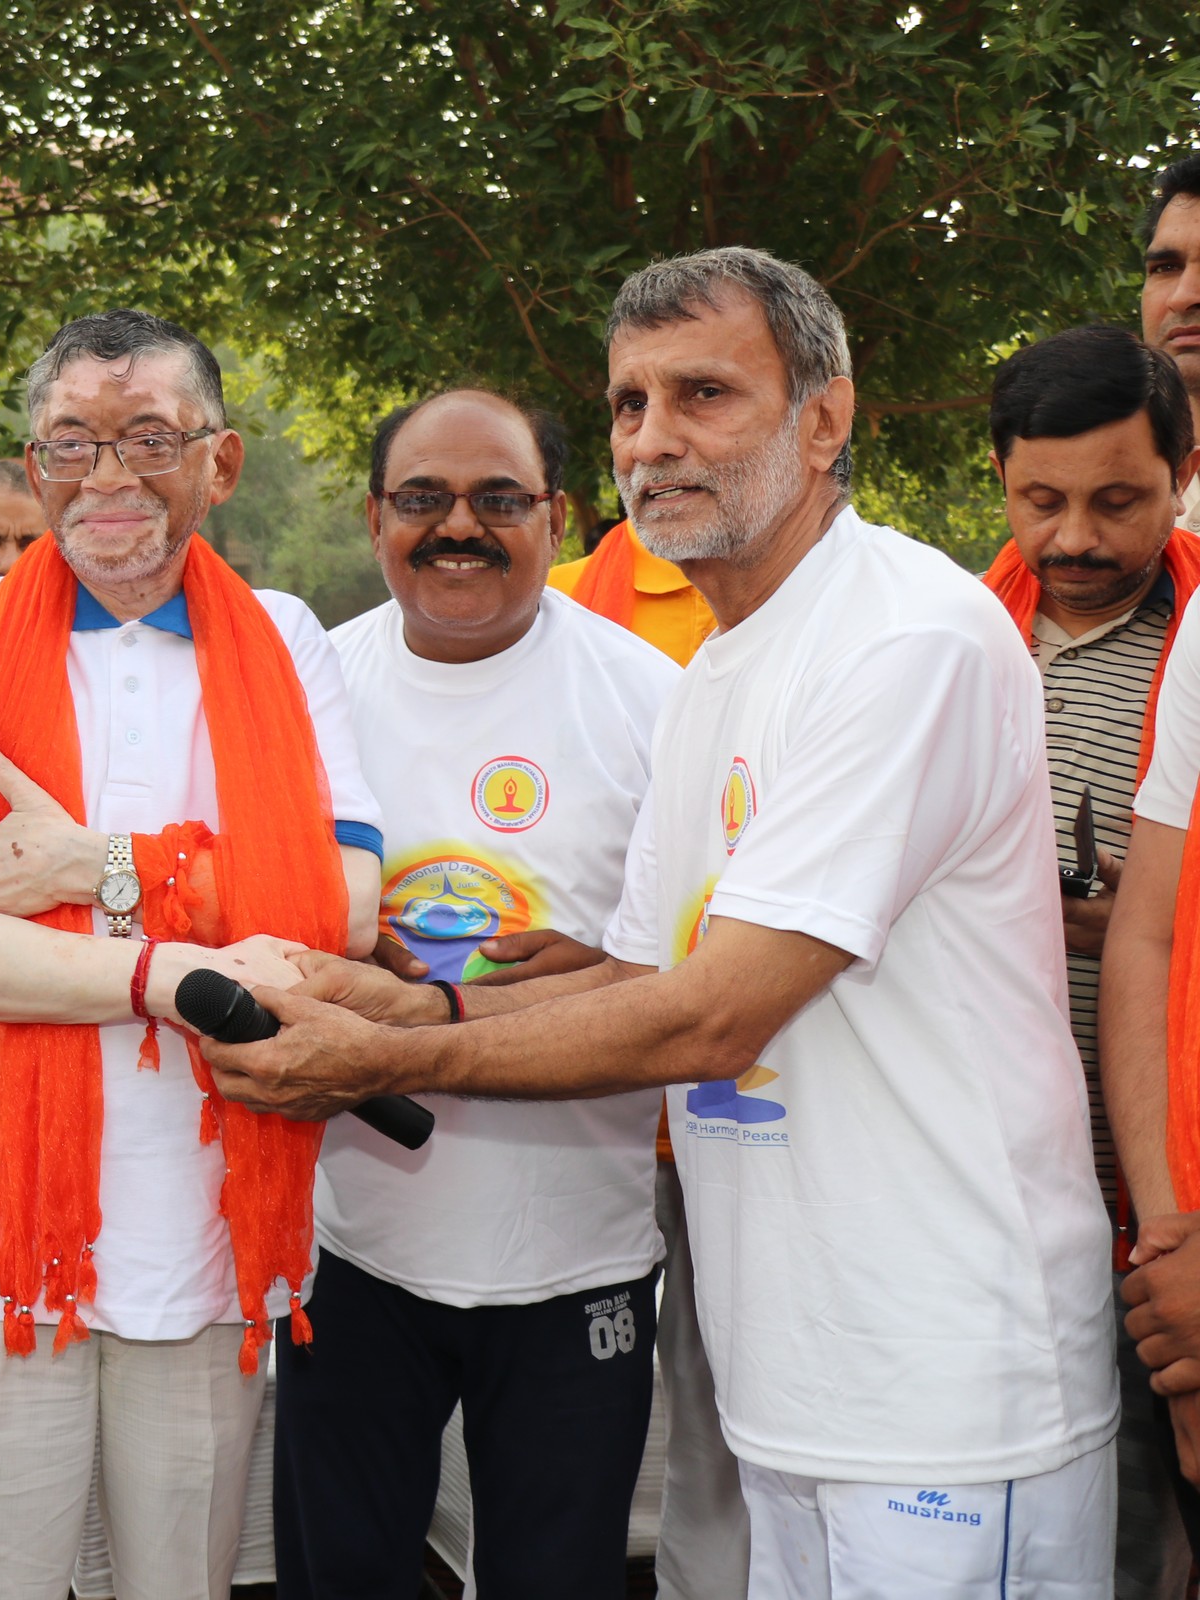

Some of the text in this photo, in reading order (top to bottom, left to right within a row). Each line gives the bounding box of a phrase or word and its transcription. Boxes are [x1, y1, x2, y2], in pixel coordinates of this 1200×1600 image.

[448, 862, 479, 874] Day
[481, 872, 499, 882] of
[430, 881, 480, 891] 21 June
[742, 1130, 789, 1142] Peace
[584, 1298, 614, 1315] SOUTH
[588, 1307, 636, 1360] 08
[887, 1499, 981, 1526] mustang
